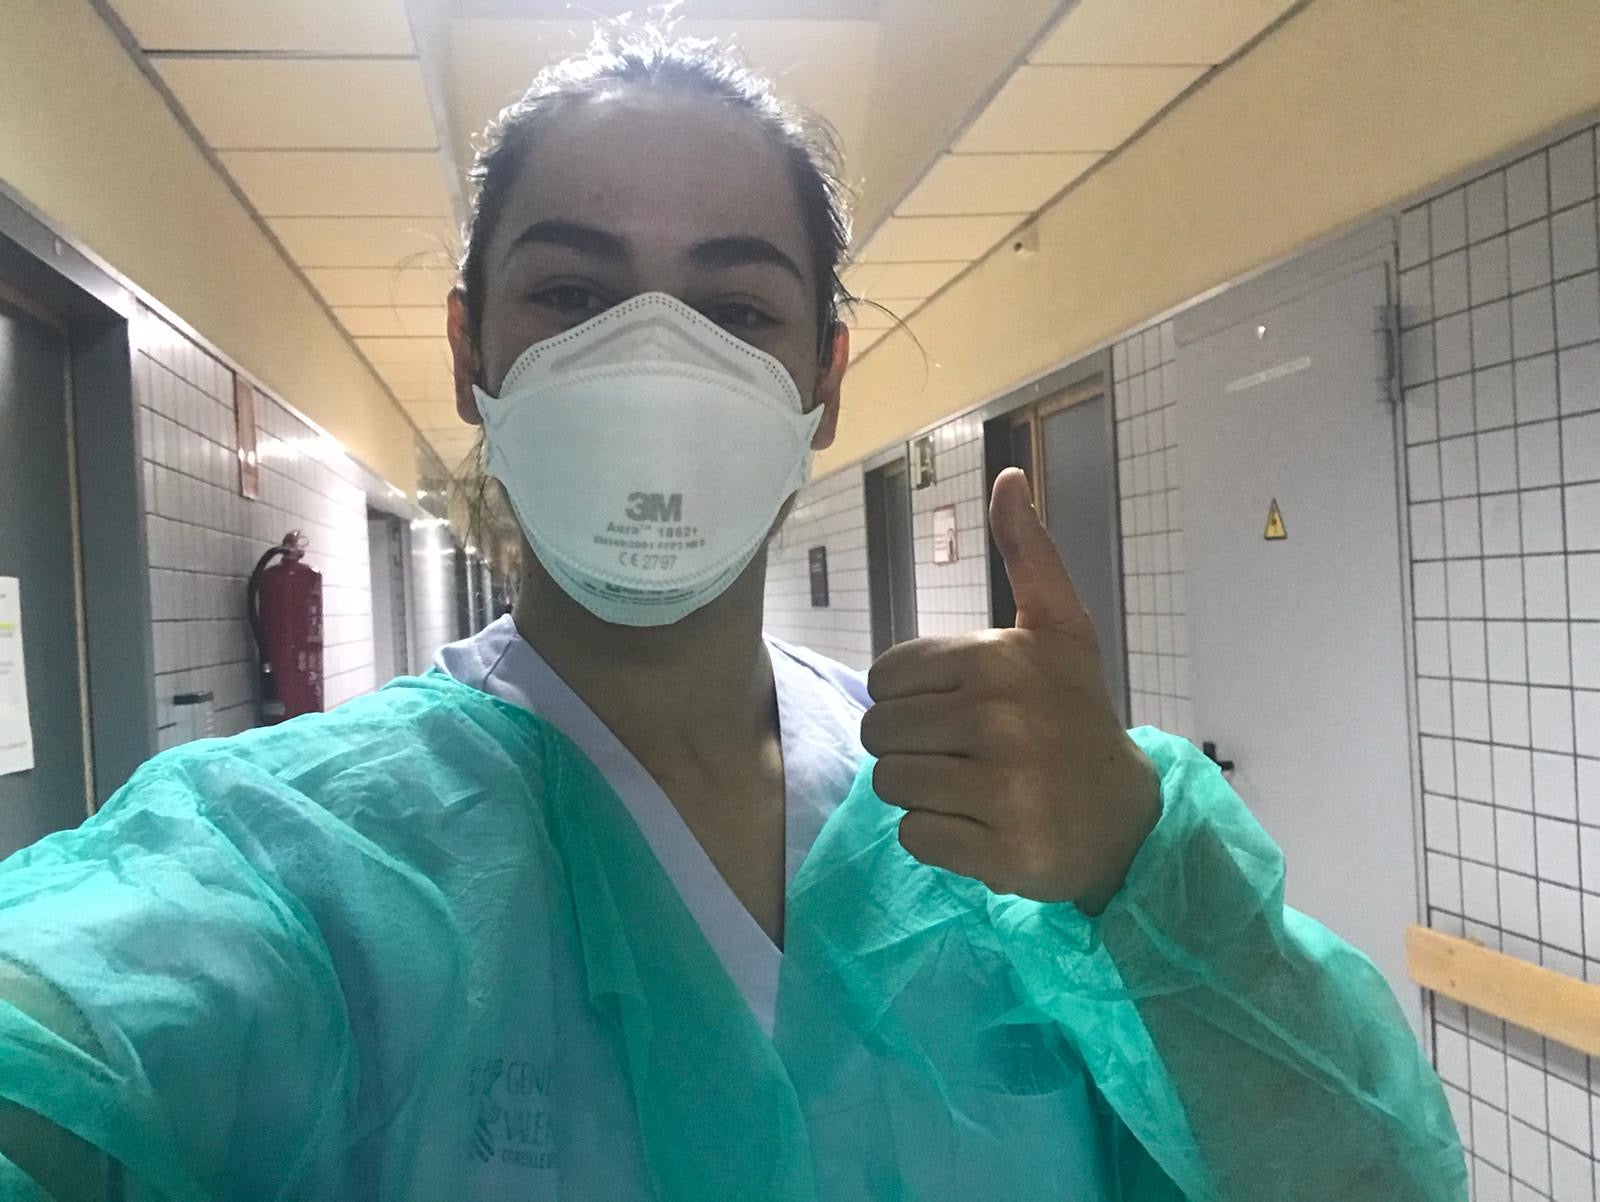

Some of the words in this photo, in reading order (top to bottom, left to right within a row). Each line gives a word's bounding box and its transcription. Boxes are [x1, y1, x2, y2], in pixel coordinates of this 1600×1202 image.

[625, 491, 683, 522] 3M
[658, 526, 698, 538] 1862+
[642, 554, 678, 570] 2797
